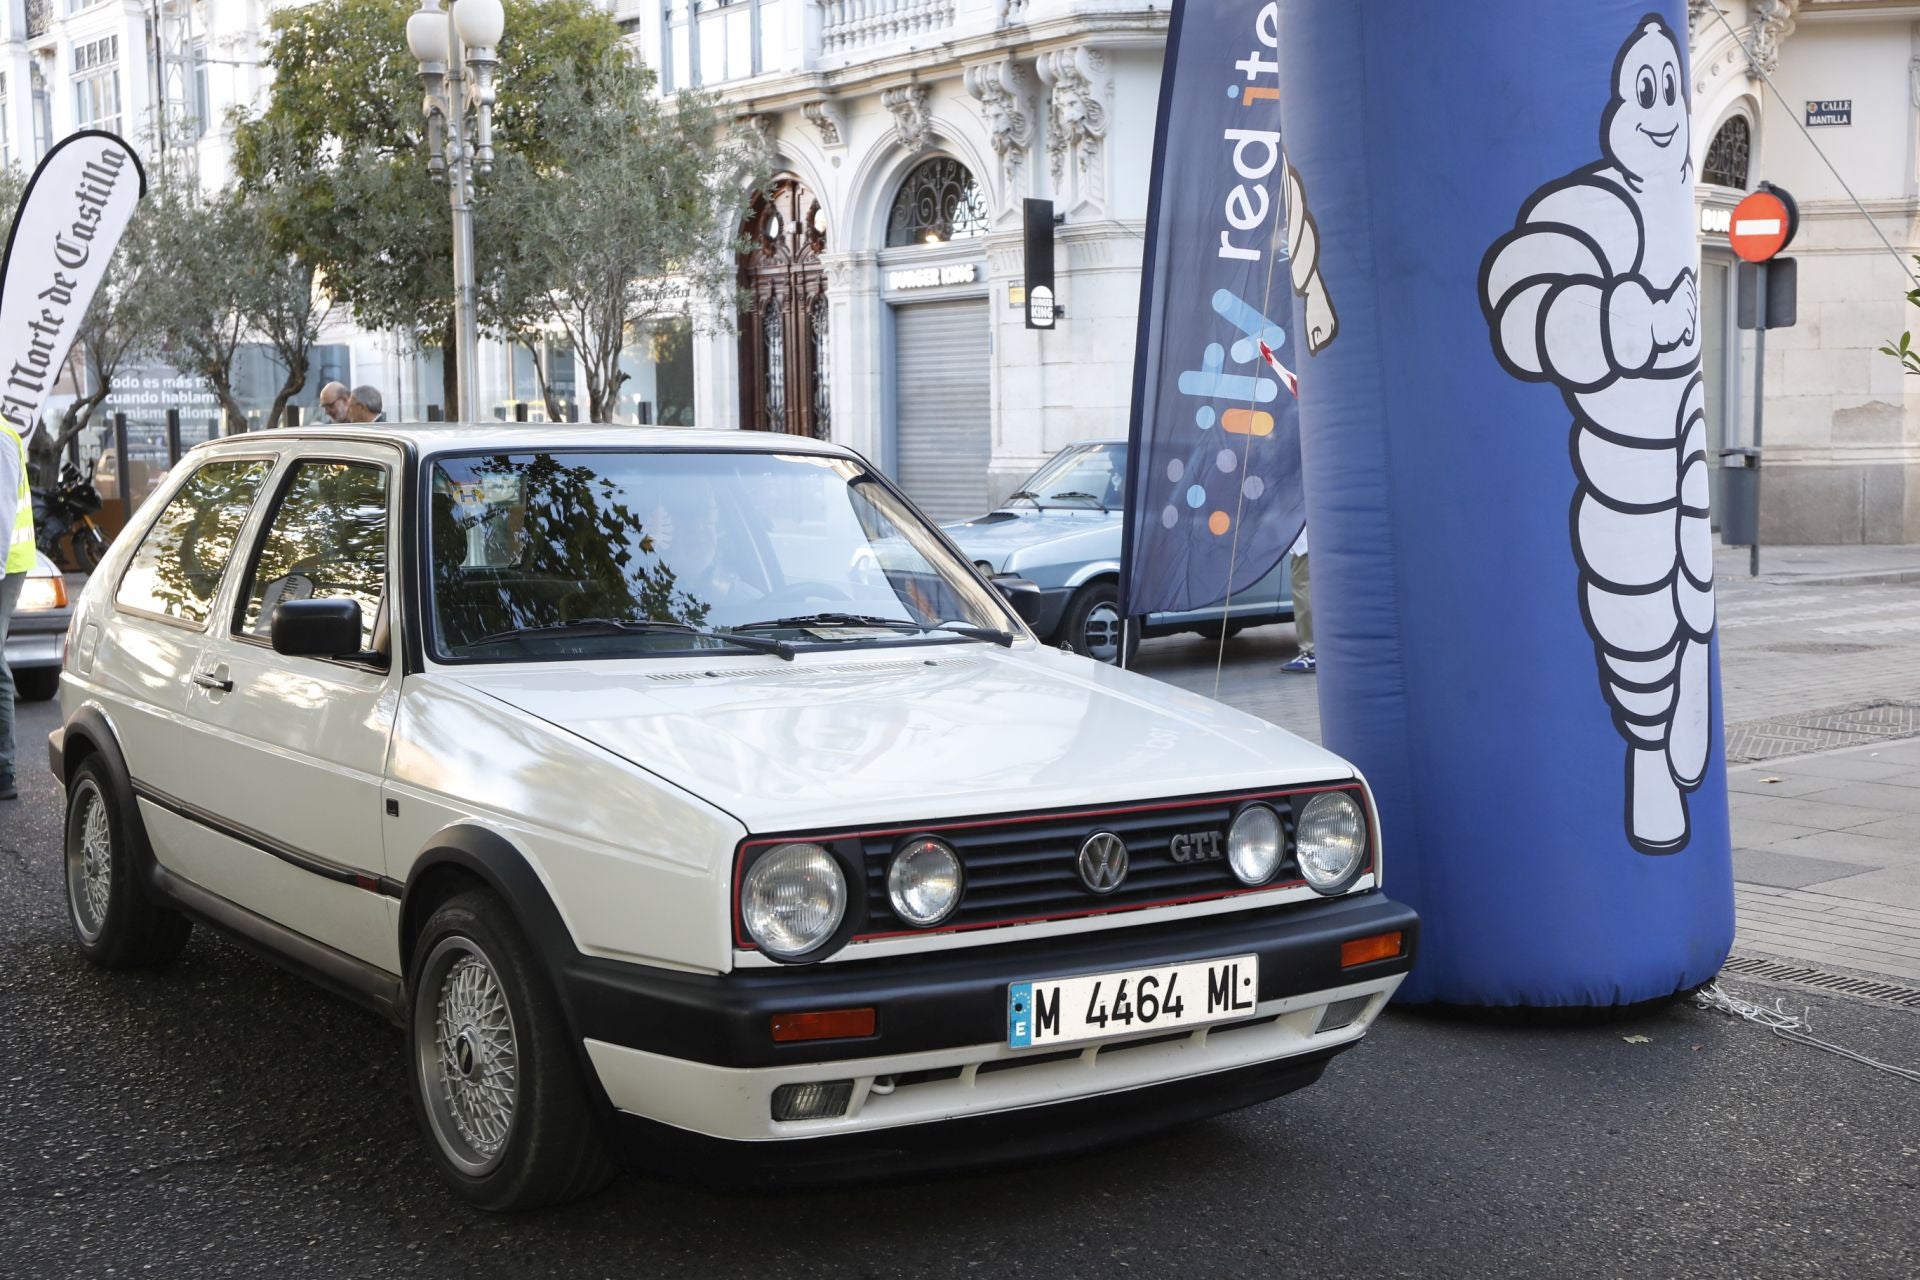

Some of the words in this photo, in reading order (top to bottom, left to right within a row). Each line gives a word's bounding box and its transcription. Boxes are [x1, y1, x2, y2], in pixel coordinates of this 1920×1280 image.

[1821, 101, 1850, 111] CALLE
[1809, 114, 1848, 124] MANTILLA
[1218, 128, 1281, 261] red
[54, 149, 126, 269] Castilla
[941, 263, 974, 285] KING
[38, 271, 77, 306] de
[1031, 305, 1053, 318] KING
[8, 308, 64, 393] Norte
[108, 375, 140, 388] odo
[143, 378, 160, 388] es
[162, 375, 192, 388] más
[105, 391, 158, 404] cuando
[161, 390, 217, 404] hablam
[174, 406, 222, 419] dioma
[1170, 830, 1222, 862] GTI
[1035, 987, 1060, 1037] M
[1086, 972, 1184, 1028] 4464
[1208, 964, 1253, 1014] ML
[1015, 1021, 1026, 1036] E
